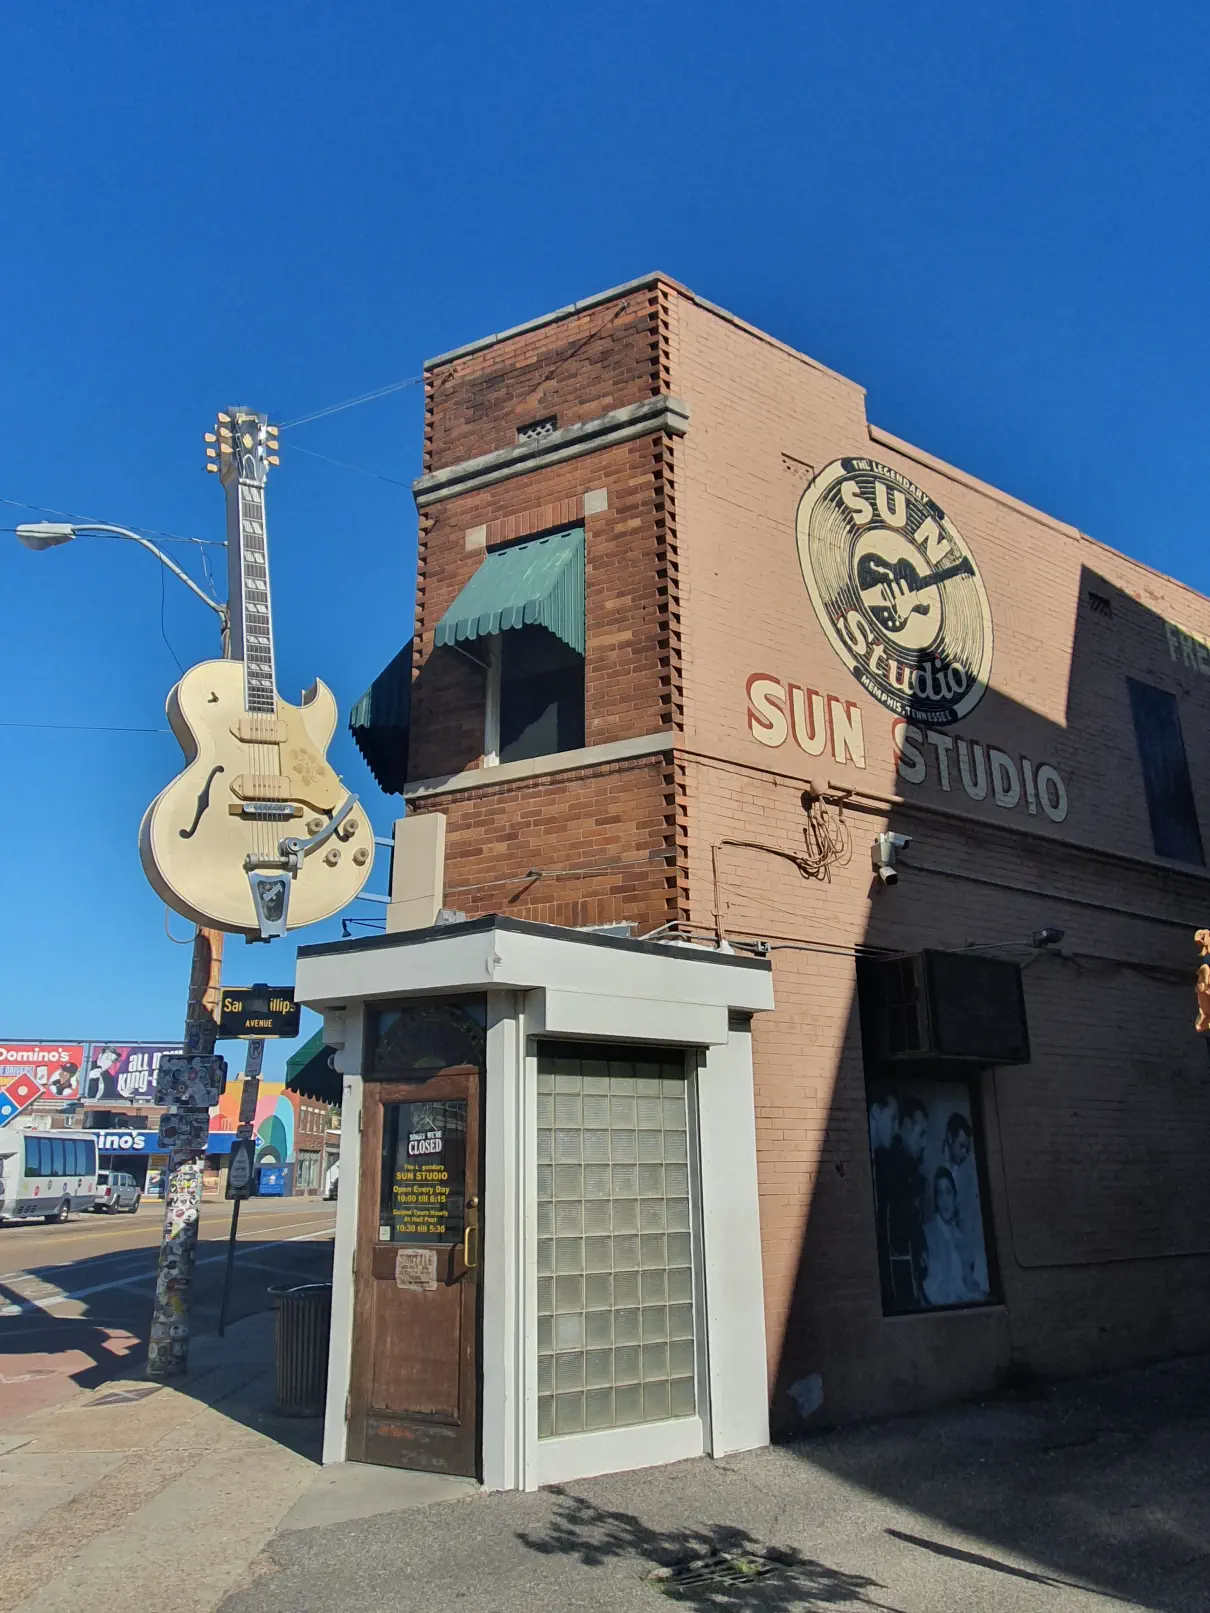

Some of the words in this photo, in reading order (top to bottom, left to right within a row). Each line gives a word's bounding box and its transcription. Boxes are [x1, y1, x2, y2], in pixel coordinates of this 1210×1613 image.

[851, 459, 870, 470] THE
[872, 460, 930, 503] LEGENDARY
[841, 480, 951, 565] SUN
[837, 607, 967, 701] Studio
[904, 706, 952, 723] TENNESSEE
[746, 672, 867, 770] SUN
[892, 717, 1069, 823] STUDIO
[223, 998, 243, 1013] Sa
[244, 1019, 273, 1028] AVENUE
[408, 1138, 442, 1155] CLOSED
[396, 1171, 414, 1180] SUN
[415, 1171, 448, 1180] STUDIO
[393, 1185, 412, 1194] Open
[413, 1185, 434, 1195] Every
[435, 1185, 450, 1195] Day
[397, 1195, 417, 1203] 10:00
[396, 1224, 416, 1232] 10:30
[417, 1225, 427, 1233] till
[429, 1225, 446, 1233] 5:30
